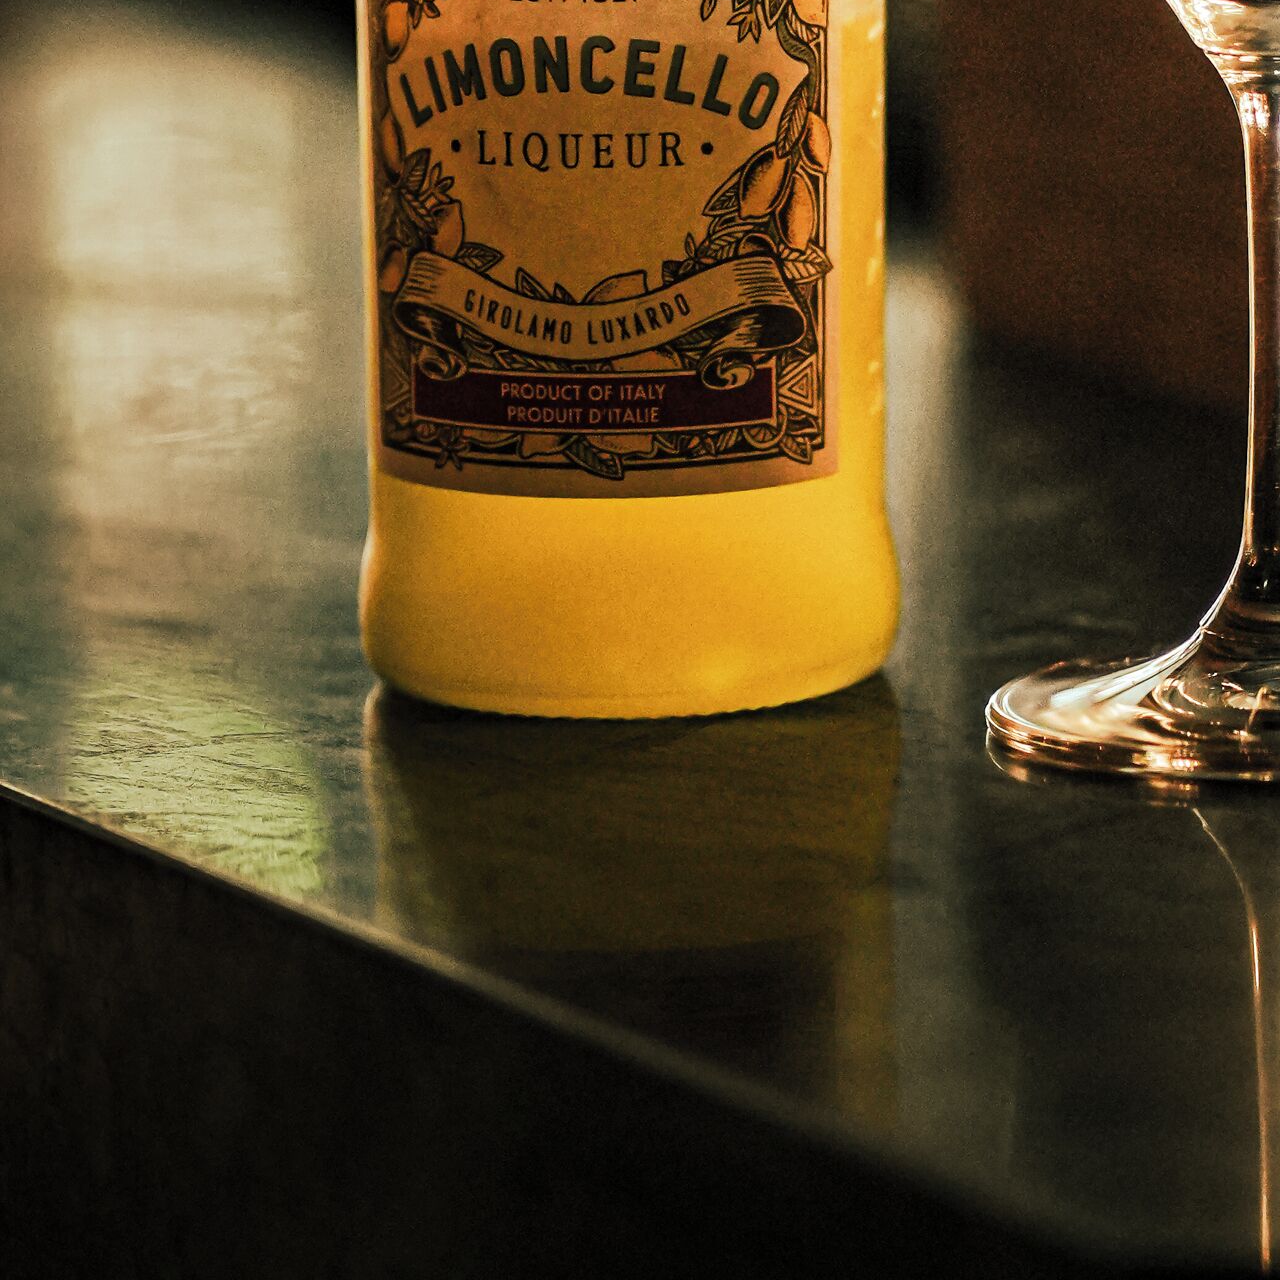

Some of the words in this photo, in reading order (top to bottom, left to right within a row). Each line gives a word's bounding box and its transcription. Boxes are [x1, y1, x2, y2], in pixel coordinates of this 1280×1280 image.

[399, 35, 781, 130] LIMONCELLO
[464, 289, 574, 346] GIROLAMO
[587, 293, 691, 346] LUXARDO
[501, 382, 581, 401] PRODUCT
[588, 383, 612, 401] OF
[619, 383, 667, 401] ITALY
[507, 405, 583, 424] PRODUIT
[589, 407, 660, 424] D'ITALIE
